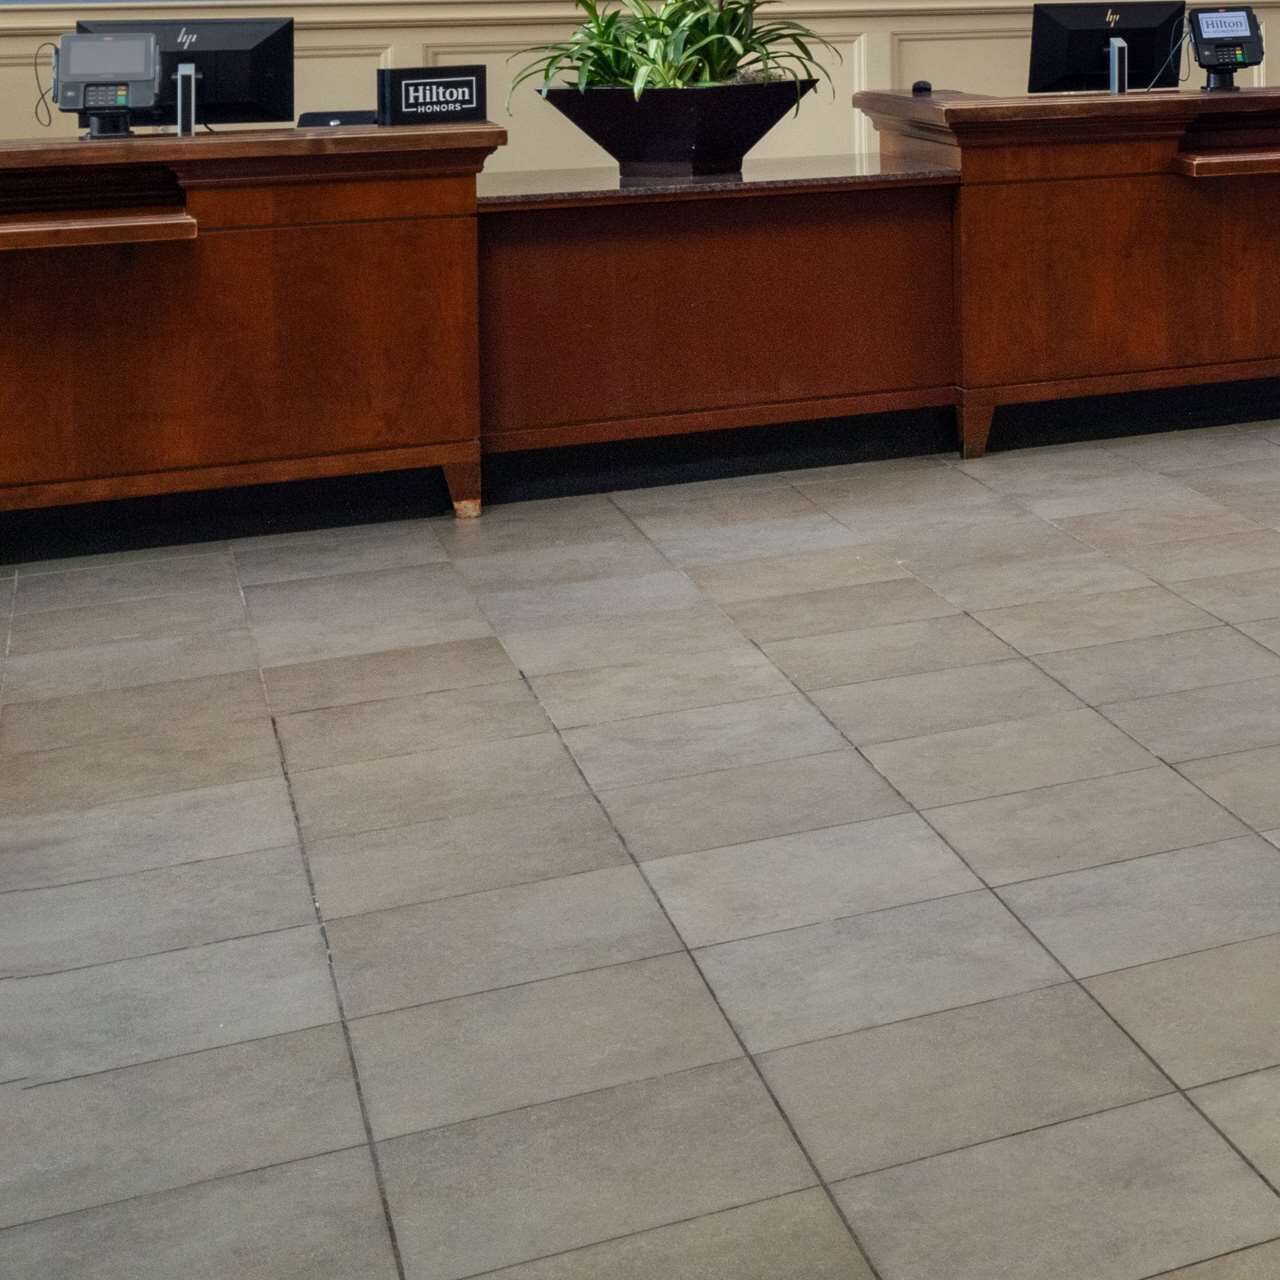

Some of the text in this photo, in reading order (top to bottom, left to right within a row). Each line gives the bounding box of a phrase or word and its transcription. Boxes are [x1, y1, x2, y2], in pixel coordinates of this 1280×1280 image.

[1204, 20, 1244, 29] Hilton
[408, 85, 470, 103] Hilton
[417, 102, 462, 113] HONORS
